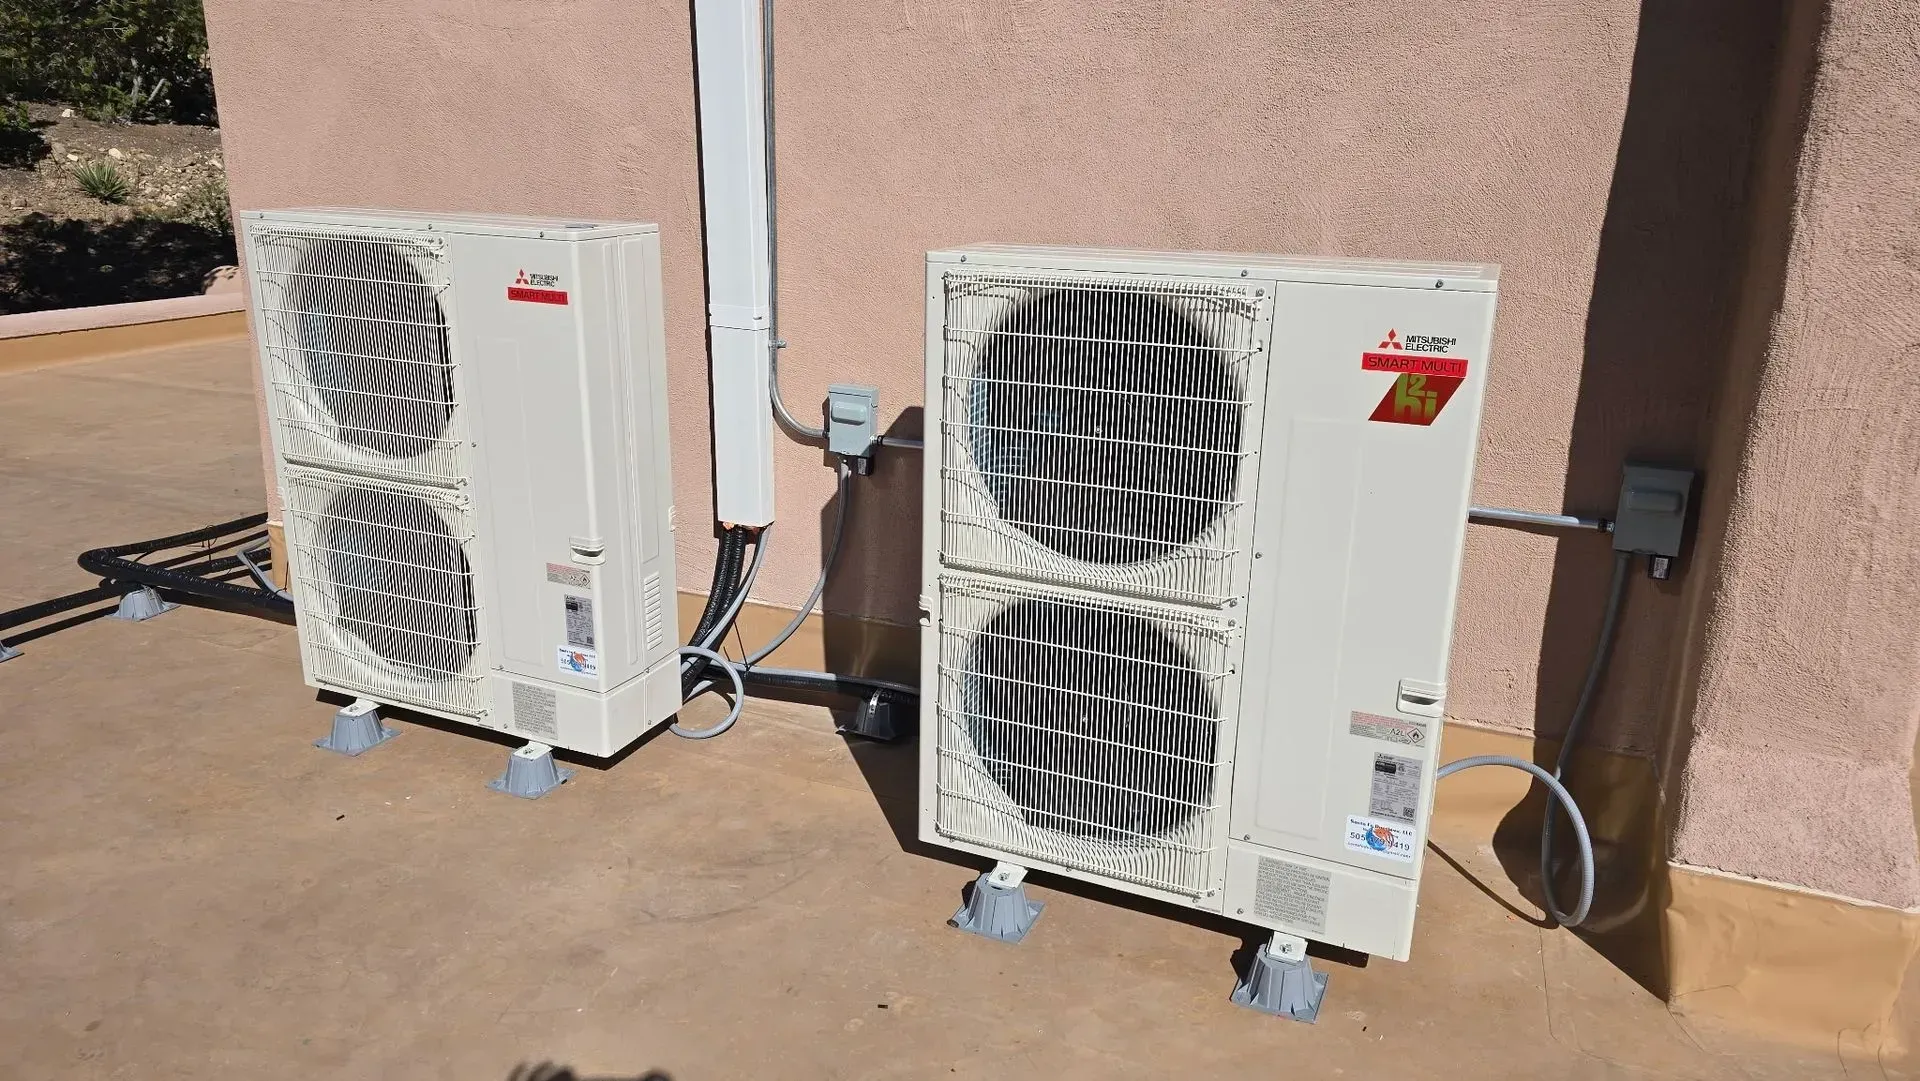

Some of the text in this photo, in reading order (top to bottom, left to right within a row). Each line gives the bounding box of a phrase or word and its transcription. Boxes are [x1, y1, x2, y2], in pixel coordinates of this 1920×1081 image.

[511, 290, 564, 302] SMART MULTI
[1406, 335, 1456, 346] MITSUBISHI
[1405, 343, 1449, 353] ELECTRIC
[1368, 356, 1462, 373] SMART MULTI
[1349, 831, 1366, 841] 505
